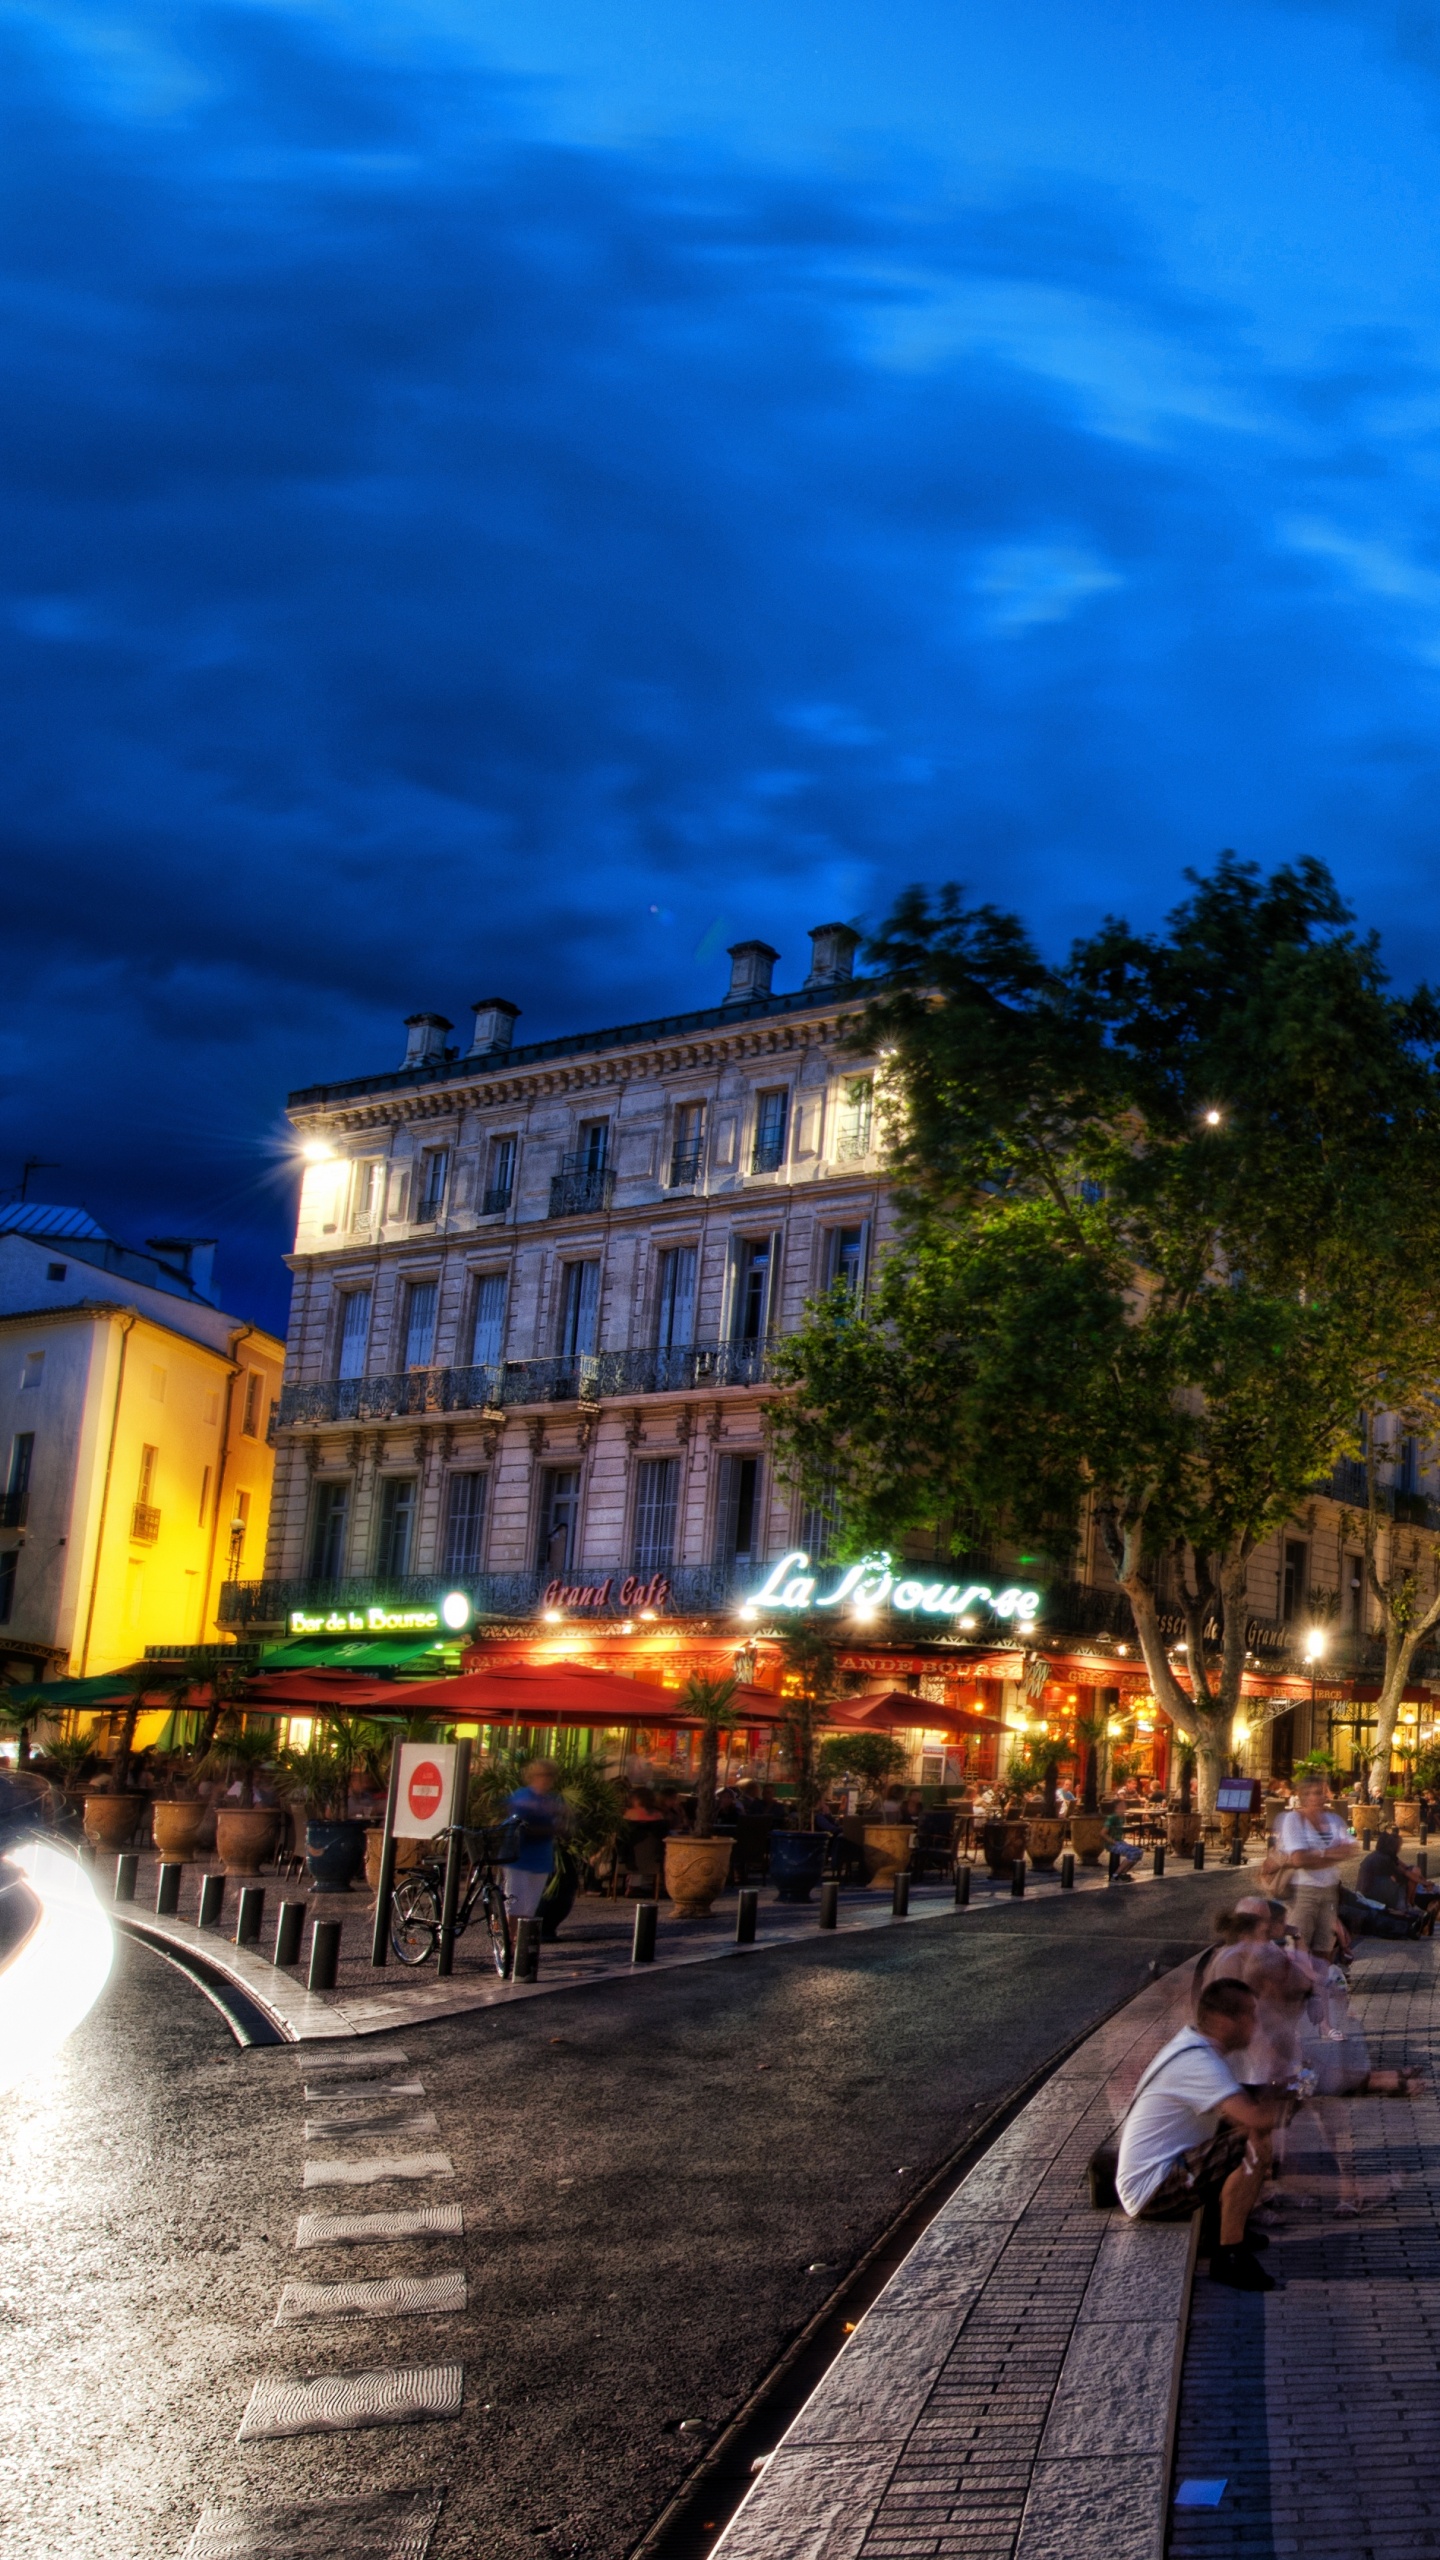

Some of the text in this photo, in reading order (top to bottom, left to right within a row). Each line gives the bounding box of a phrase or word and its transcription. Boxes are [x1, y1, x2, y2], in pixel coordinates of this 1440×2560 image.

[543, 1573, 670, 1609] Grand Café
[746, 1550, 1040, 1620] La Bourse
[291, 1607, 438, 1633] Bar de la Bourse
[832, 1657, 914, 1672] ANDE
